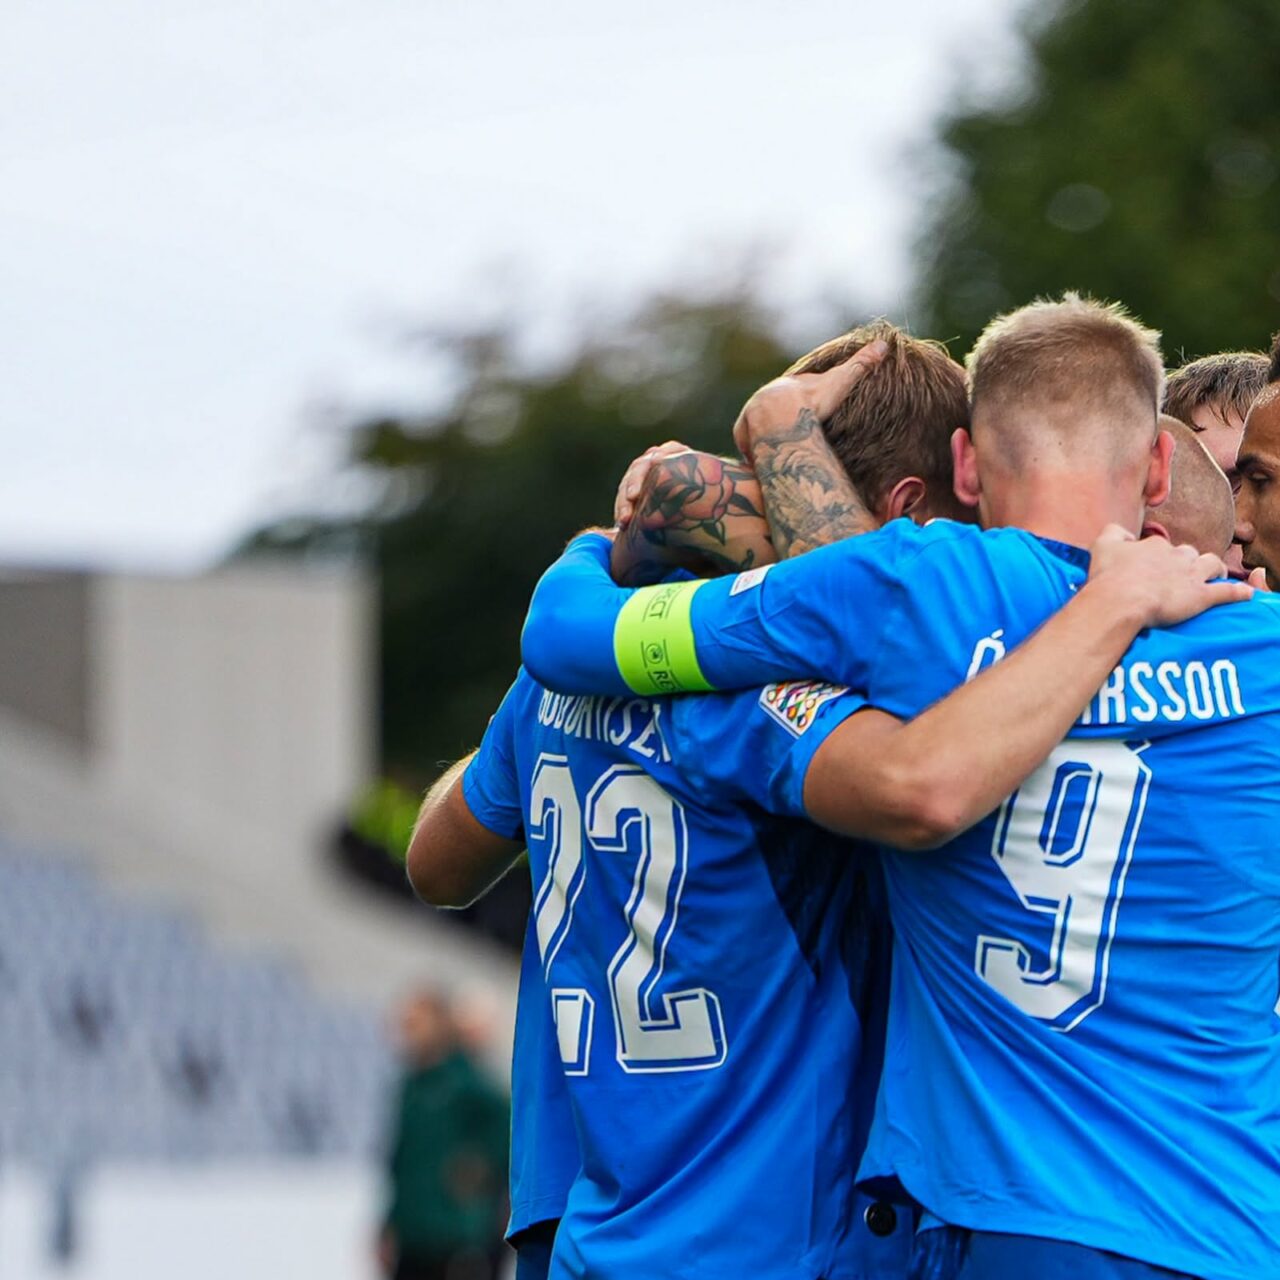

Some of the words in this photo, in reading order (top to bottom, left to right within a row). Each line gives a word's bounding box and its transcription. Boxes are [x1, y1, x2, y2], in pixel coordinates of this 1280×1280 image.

[964, 629, 1246, 725] ÓRSSON
[531, 752, 728, 1077] 22
[975, 738, 1153, 1033] 9
